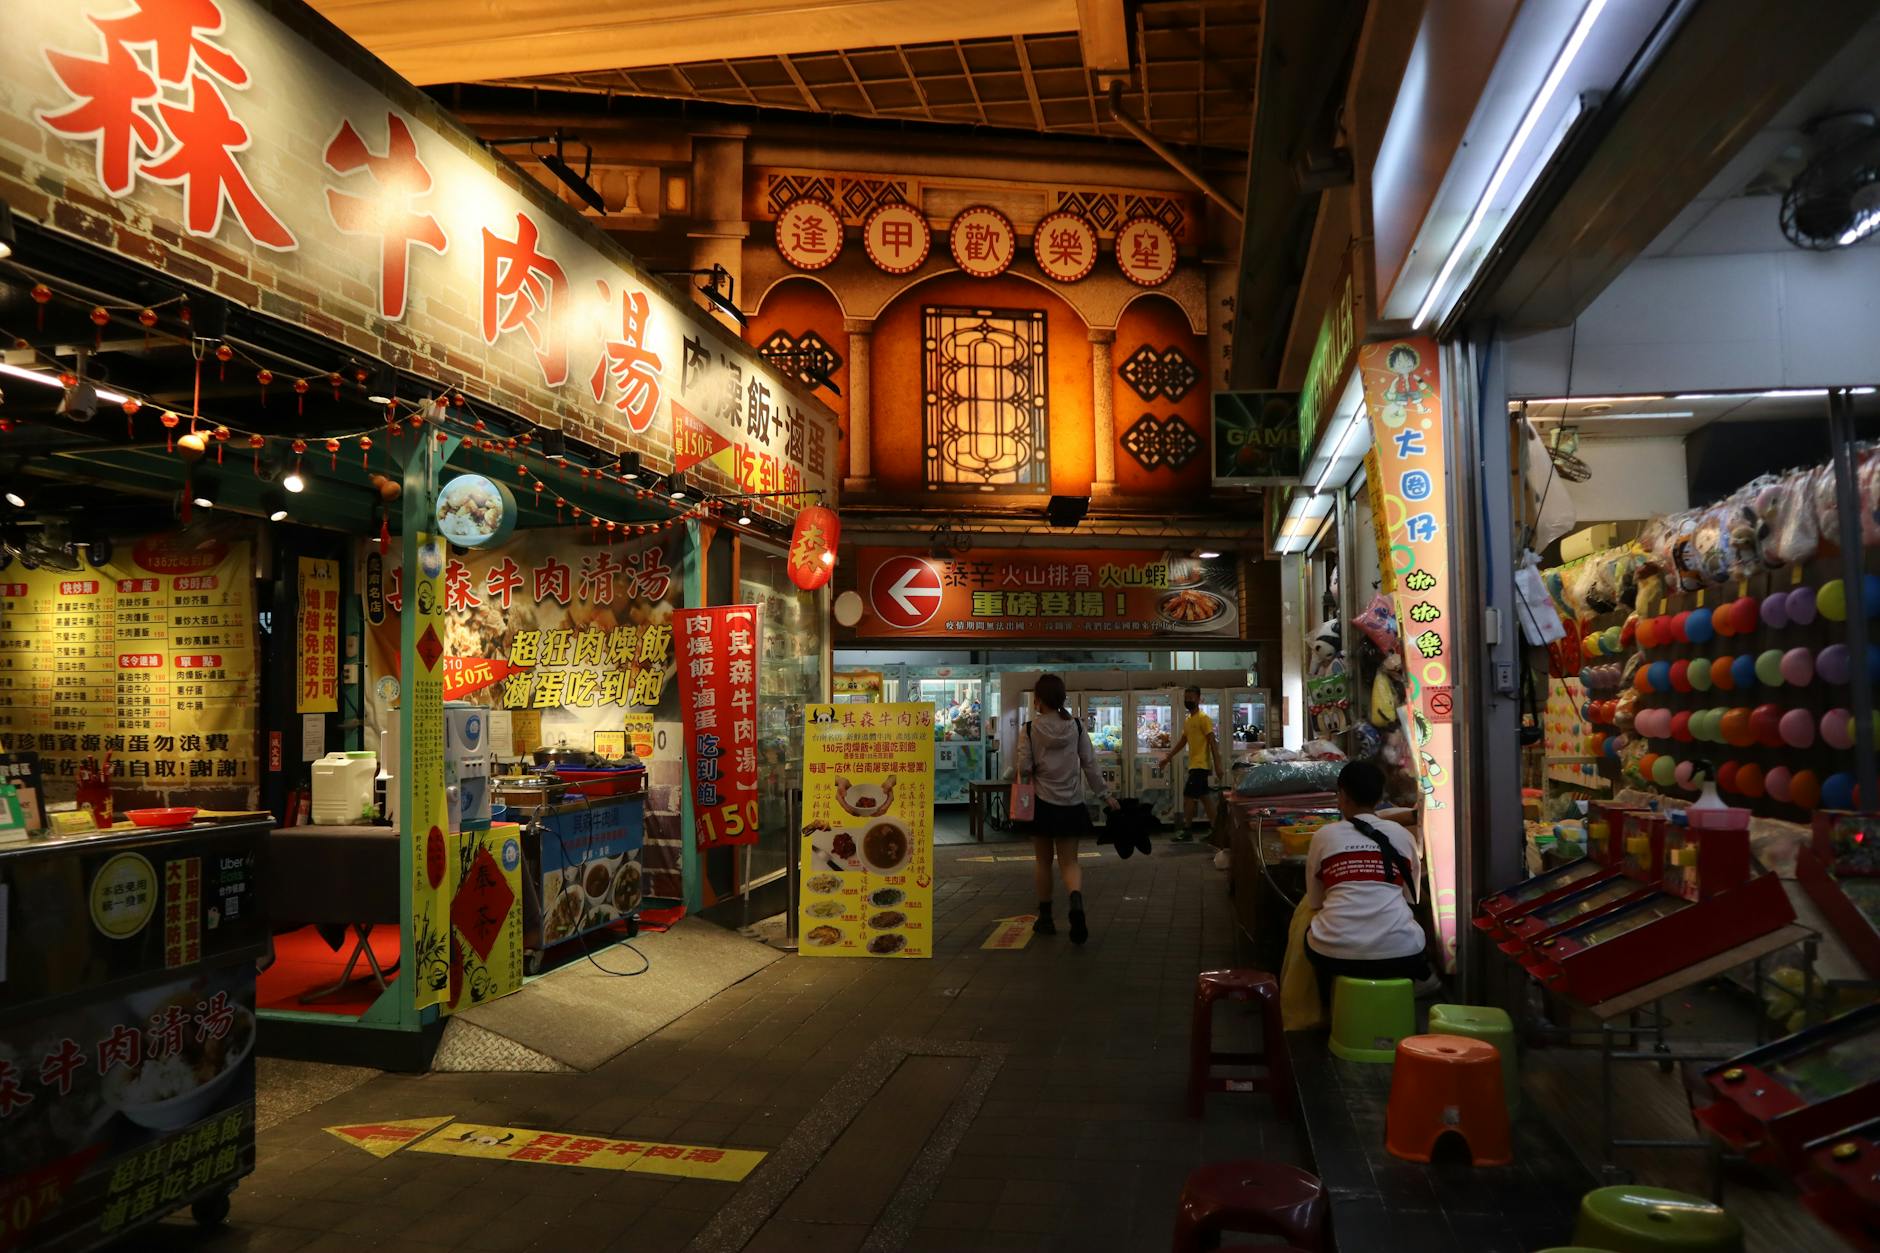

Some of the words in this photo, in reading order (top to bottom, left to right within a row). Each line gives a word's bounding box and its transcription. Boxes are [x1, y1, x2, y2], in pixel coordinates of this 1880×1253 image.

[791, 213, 1163, 271] 逢甲歡樂星
[1392, 427, 1439, 546] 大圈仔
[791, 523, 829, 573] 森
[507, 623, 673, 667] 超狂肉燥飯
[502, 668, 665, 709] 滷蛋吃到飽
[842, 710, 932, 728] 其森牛肉湯
[702, 799, 760, 842] 150
[219, 856, 245, 871] Uber
